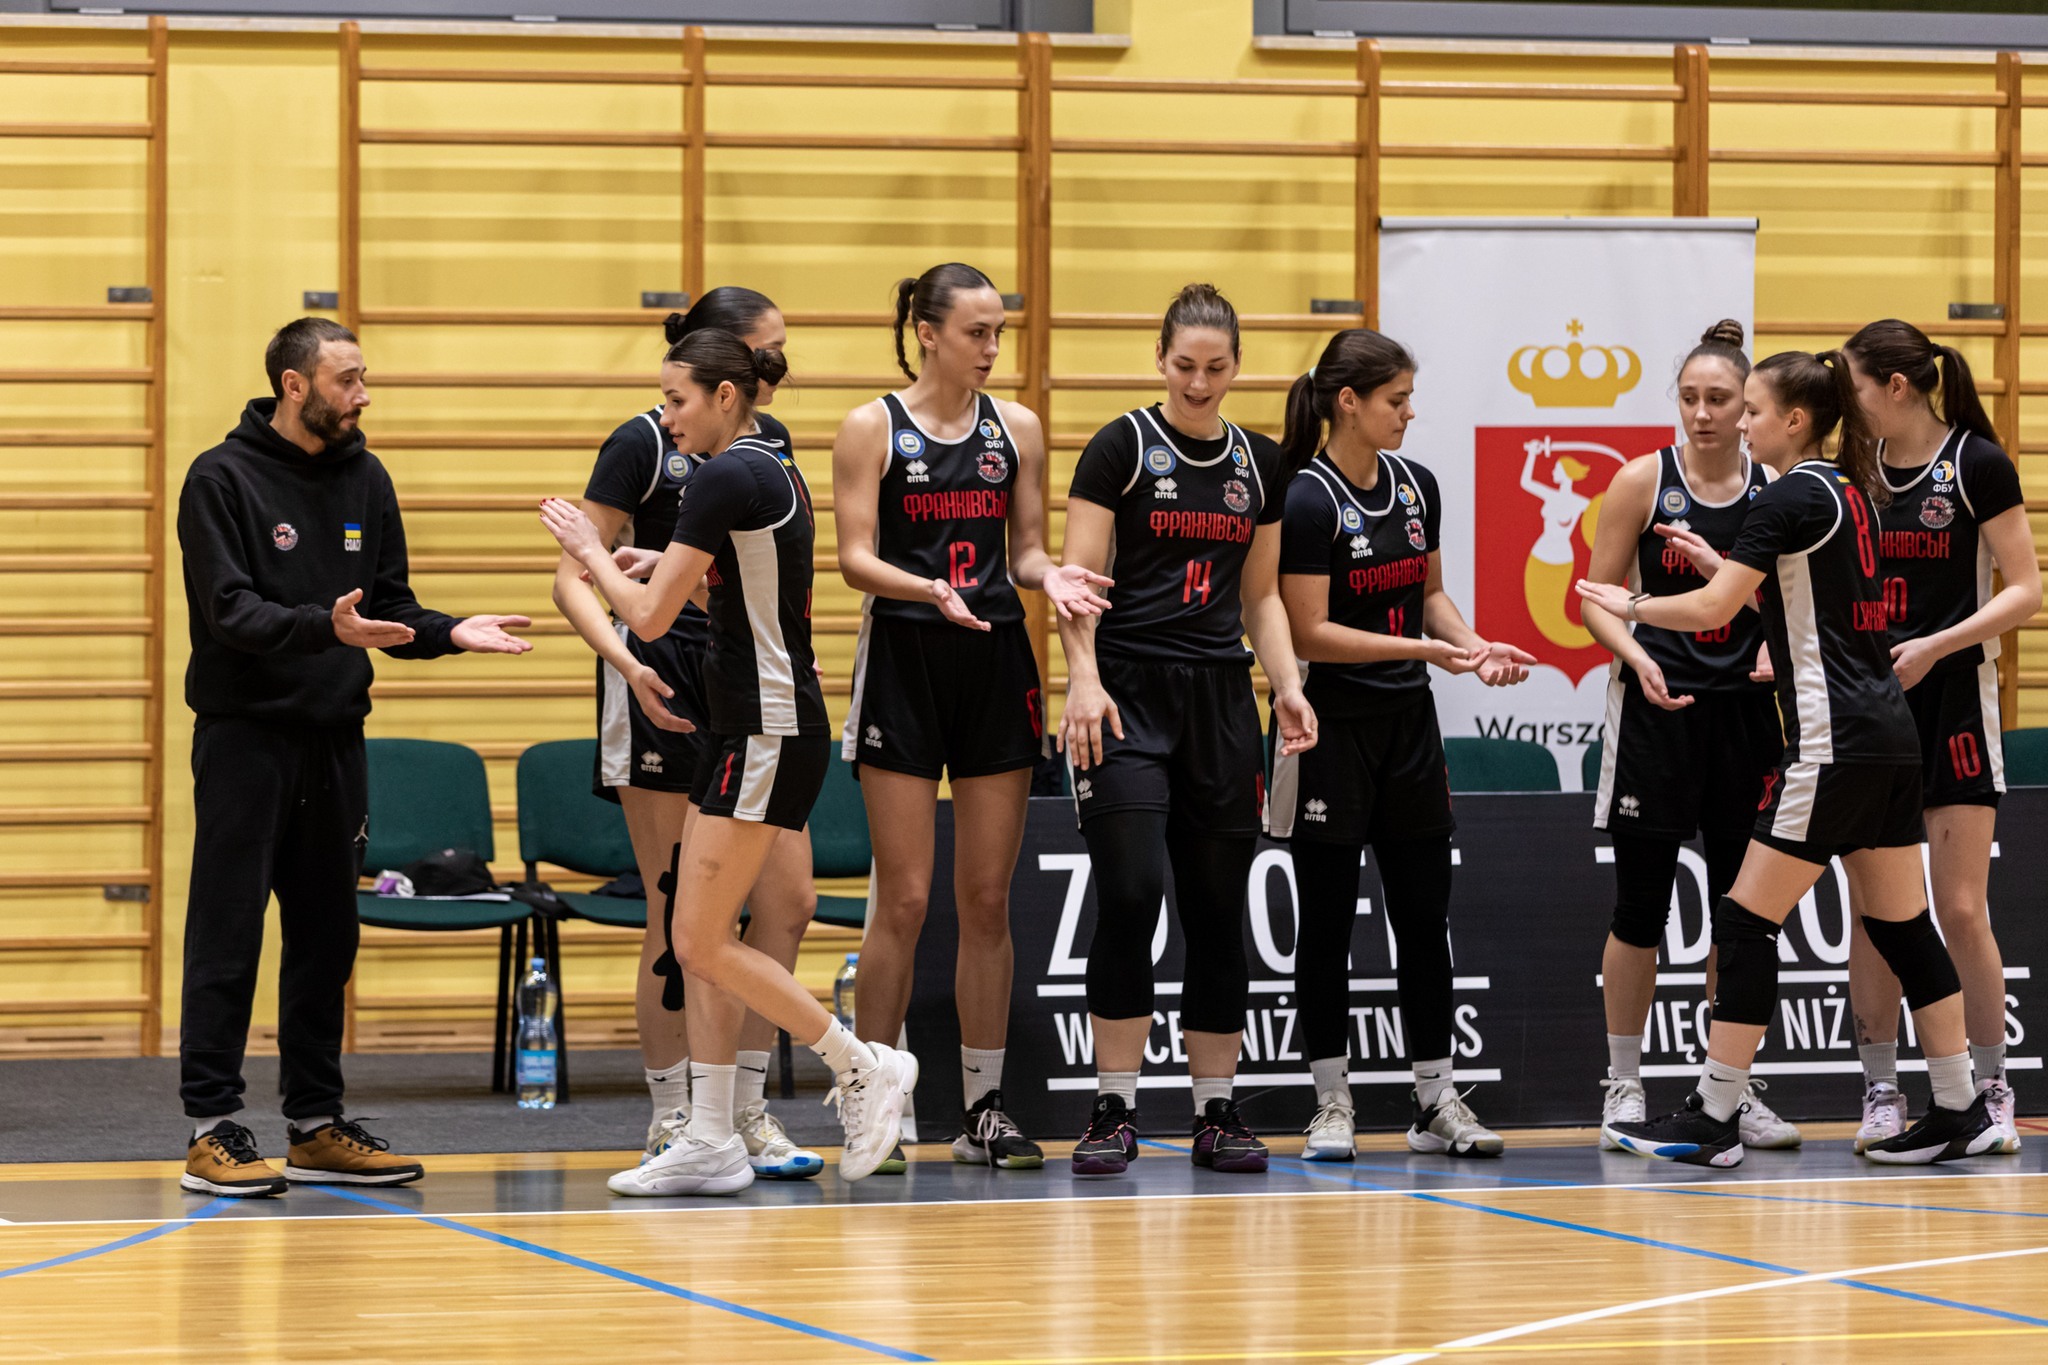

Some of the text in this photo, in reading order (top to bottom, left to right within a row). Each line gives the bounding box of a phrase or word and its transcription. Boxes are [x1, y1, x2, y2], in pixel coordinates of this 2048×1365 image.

[985, 440, 1004, 449] ФБУ
[907, 473, 930, 483] errea
[1234, 467, 1250, 479] ФБУ
[1932, 483, 1954, 493] ФБУ
[1154, 491, 1178, 500] errea
[1405, 504, 1420, 516] ФБУ
[1150, 511, 1253, 545] ФРАНКІВСЬК
[1845, 485, 1876, 578] 8
[1351, 547, 1373, 559] errea
[1879, 531, 1951, 560] НКІВСЬК
[949, 541, 979, 589] 12
[1349, 554, 1429, 596] ФРАНКІВСЬ
[1183, 559, 1212, 605] 14
[1883, 577, 1907, 623] 10
[1474, 715, 1605, 745] Warsz
[641, 763, 663, 774] errea
[1948, 731, 1982, 780] 10
[1237, 995, 1302, 1061] NIŻ
[1780, 984, 1852, 1050] NIŻ
